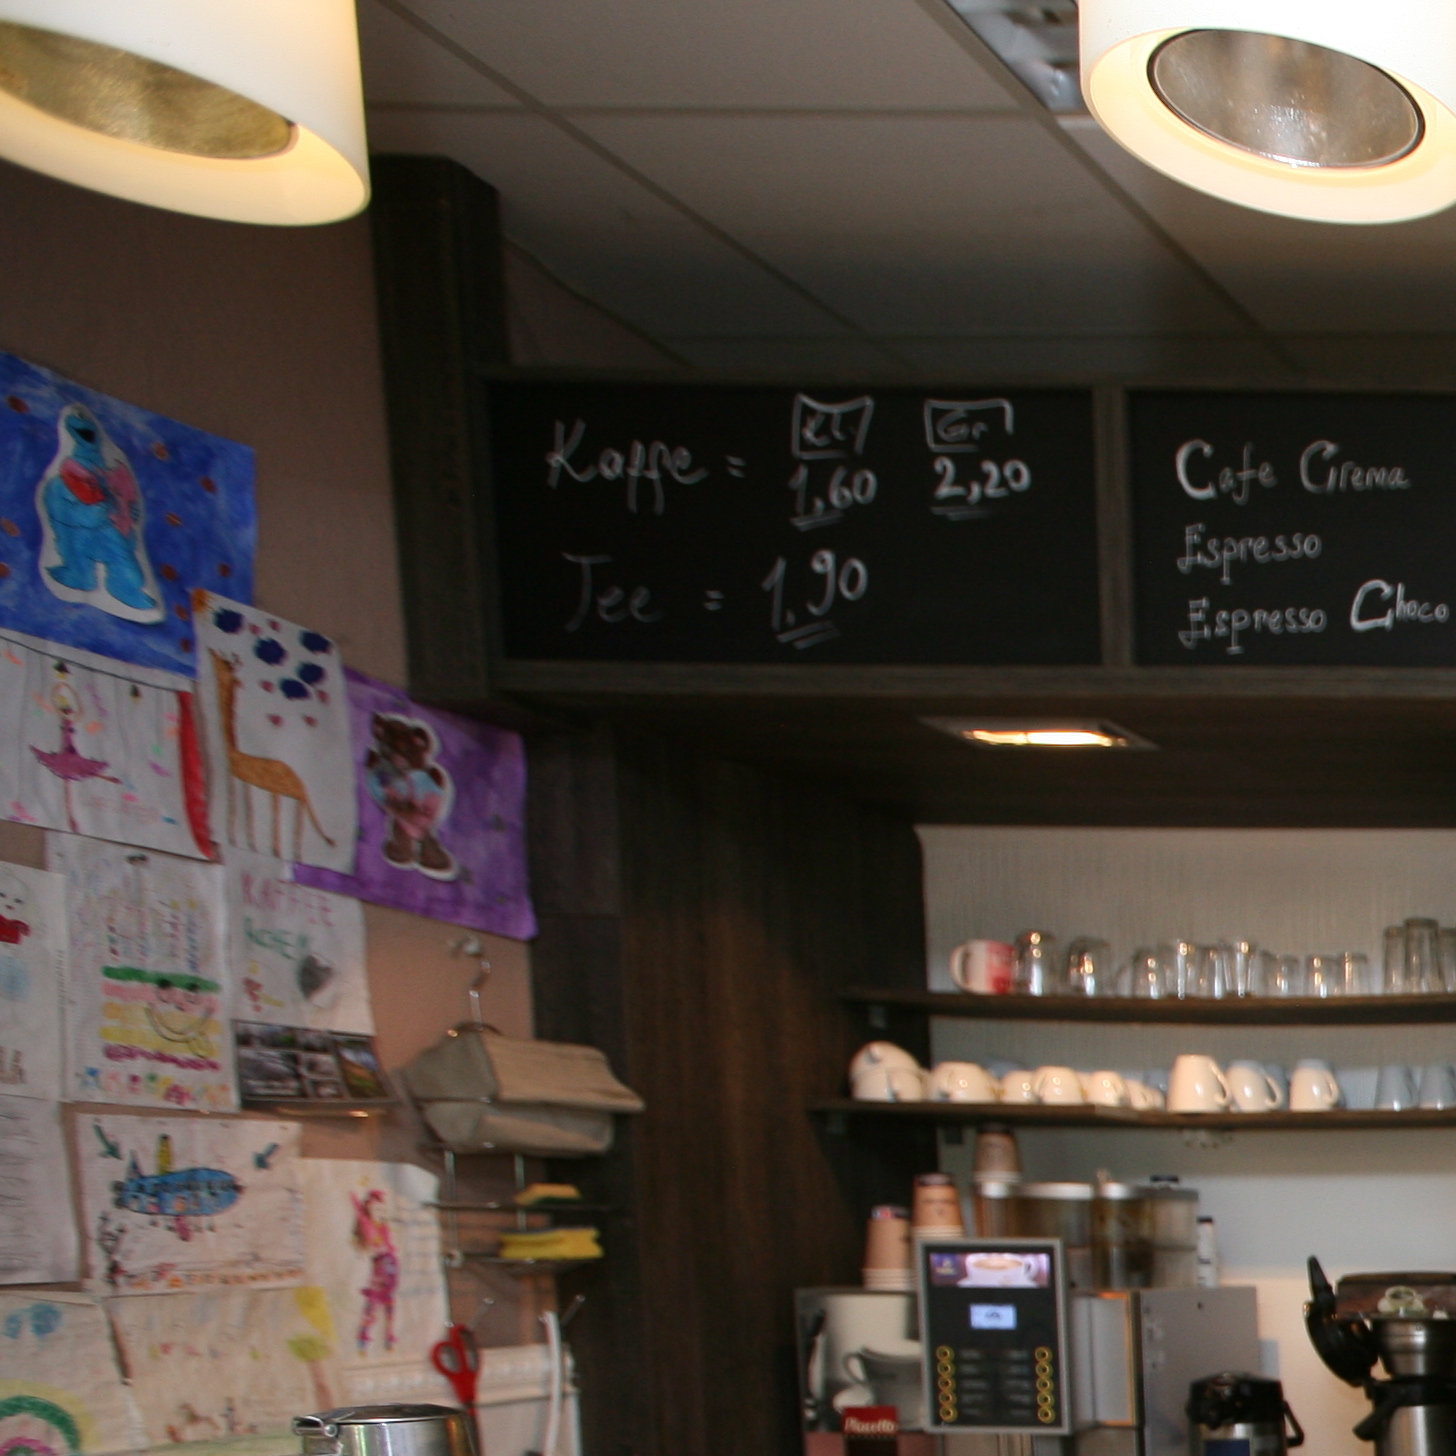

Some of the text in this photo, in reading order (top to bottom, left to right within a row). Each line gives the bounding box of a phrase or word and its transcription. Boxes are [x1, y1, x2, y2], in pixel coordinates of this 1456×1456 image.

[933, 455, 1032, 505] 2,20
[1175, 439, 1275, 506] Cafe
[1176, 523, 1323, 585] Espresso
[1178, 598, 1328, 654] Espresso
[1350, 578, 1450, 632] Choco
